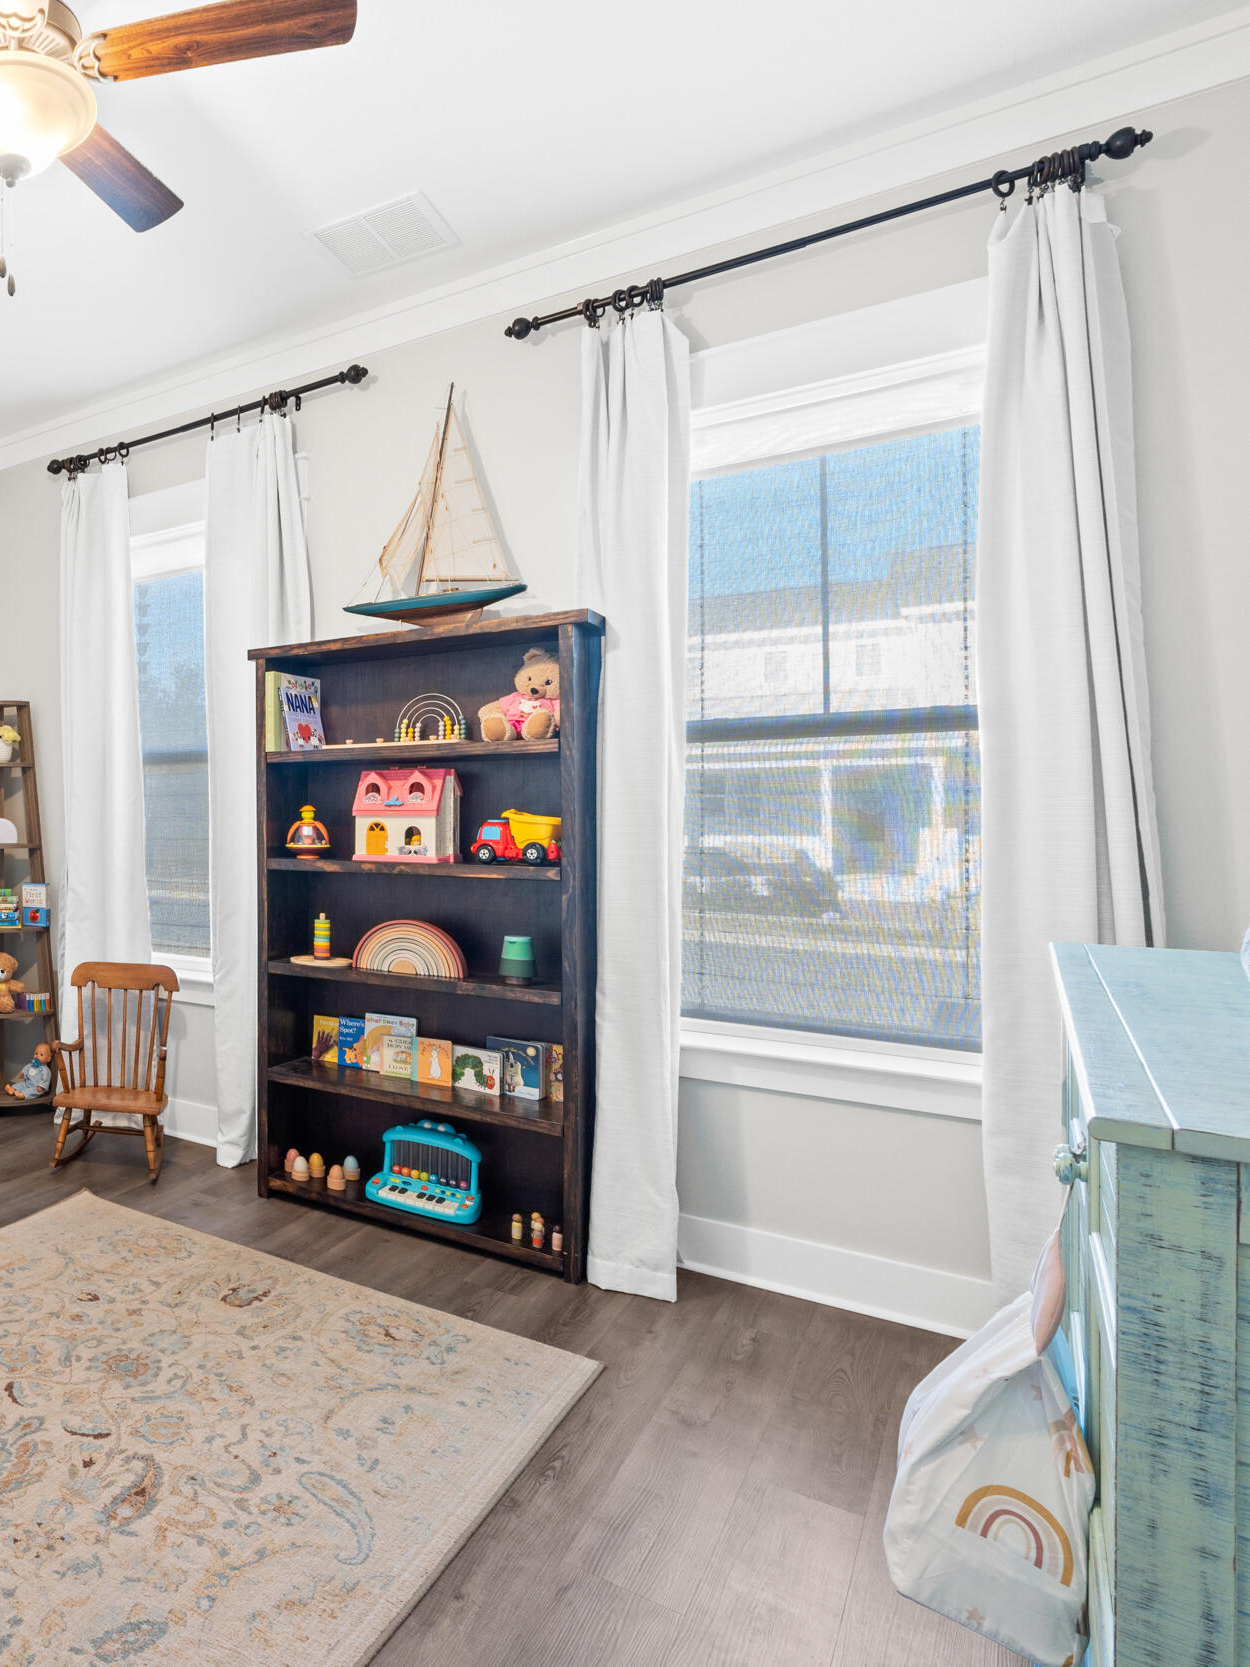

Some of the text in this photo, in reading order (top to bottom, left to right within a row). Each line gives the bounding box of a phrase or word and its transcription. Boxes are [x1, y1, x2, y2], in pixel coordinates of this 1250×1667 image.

[286, 692, 316, 715] NANA
[340, 1018, 365, 1027] Where's
[339, 1026, 357, 1034] Spot?
